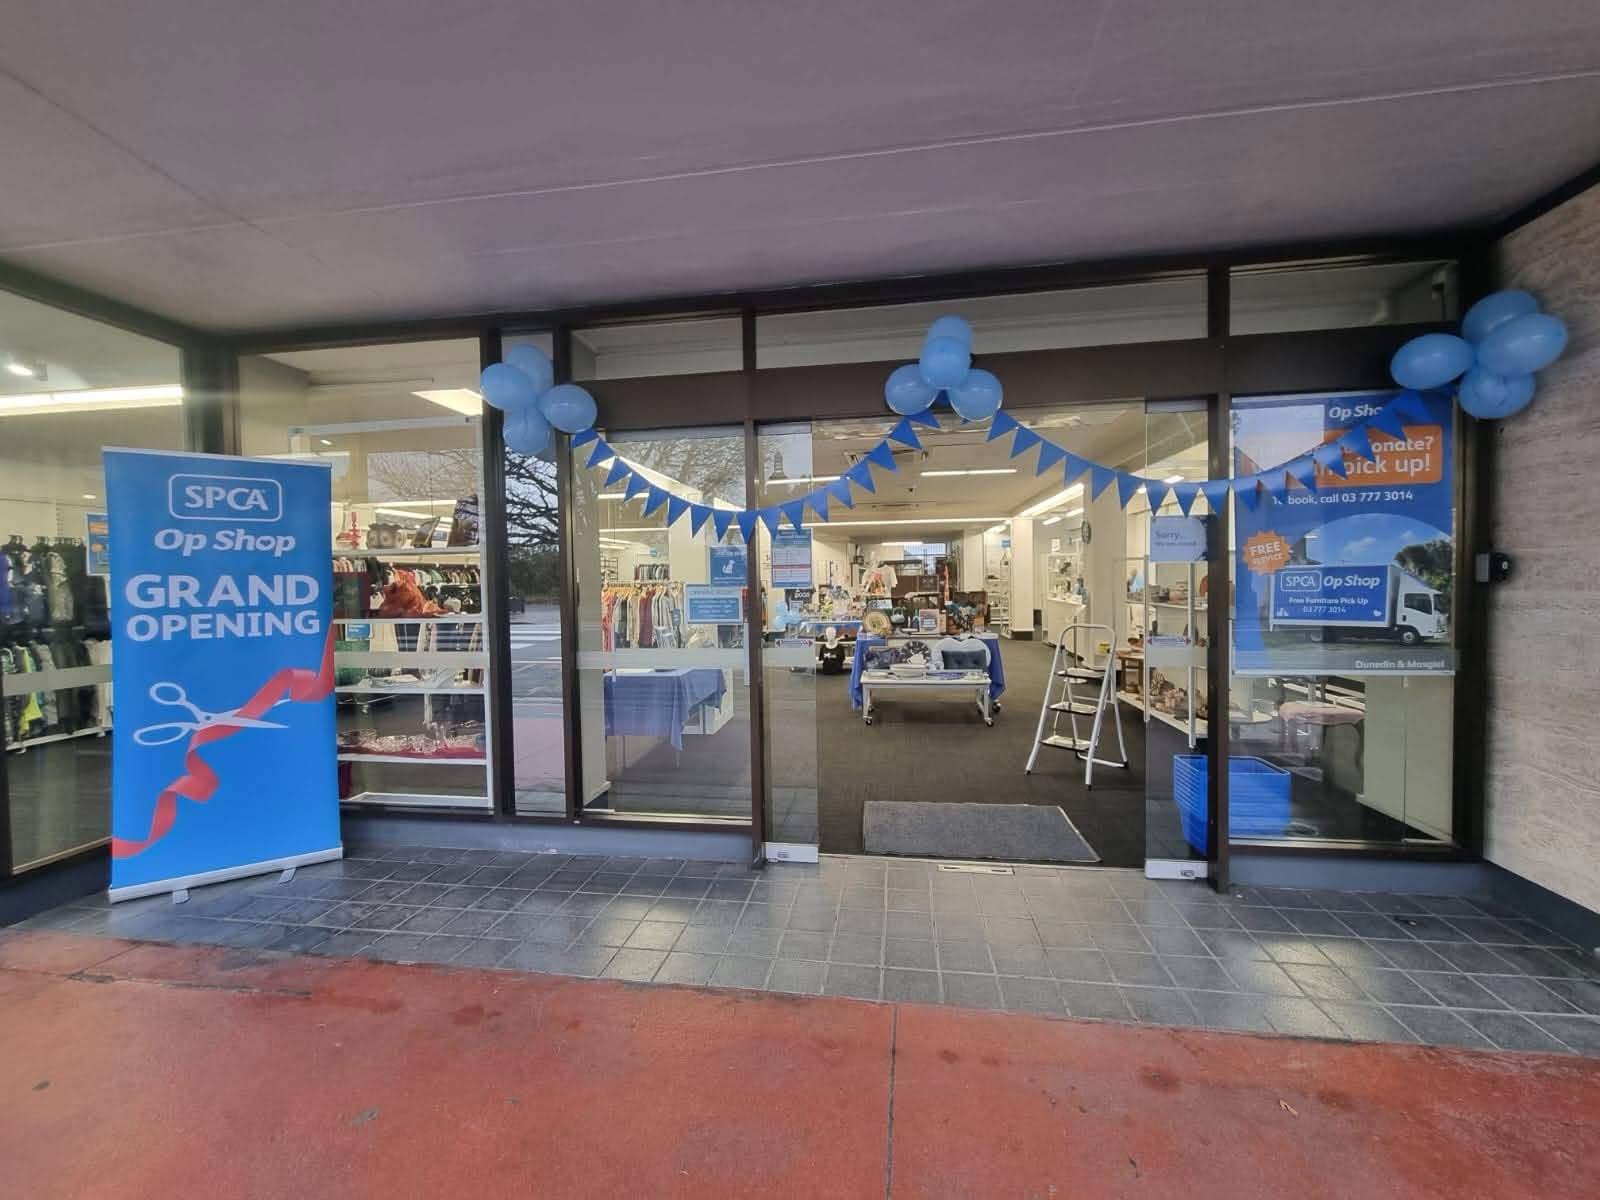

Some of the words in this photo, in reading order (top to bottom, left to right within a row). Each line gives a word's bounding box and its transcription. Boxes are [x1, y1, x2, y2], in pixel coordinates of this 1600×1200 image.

[1329, 406, 1352, 421] Op
[1370, 436, 1434, 453] onate?
[1395, 453, 1431, 477] up!
[184, 485, 269, 511] SPCA
[1320, 493, 1339, 504] call
[1342, 492, 1356, 503] 03
[1360, 491, 1381, 502] 777
[1384, 490, 1414, 501] 3014
[154, 528, 208, 557] Op
[213, 528, 296, 557] Shop
[1249, 541, 1280, 554] FREE
[125, 574, 320, 609] GRAND
[1285, 575, 1316, 587] SPCA
[1323, 575, 1343, 590] Op
[1344, 573, 1381, 590] Shop
[126, 610, 320, 642] OPENING
